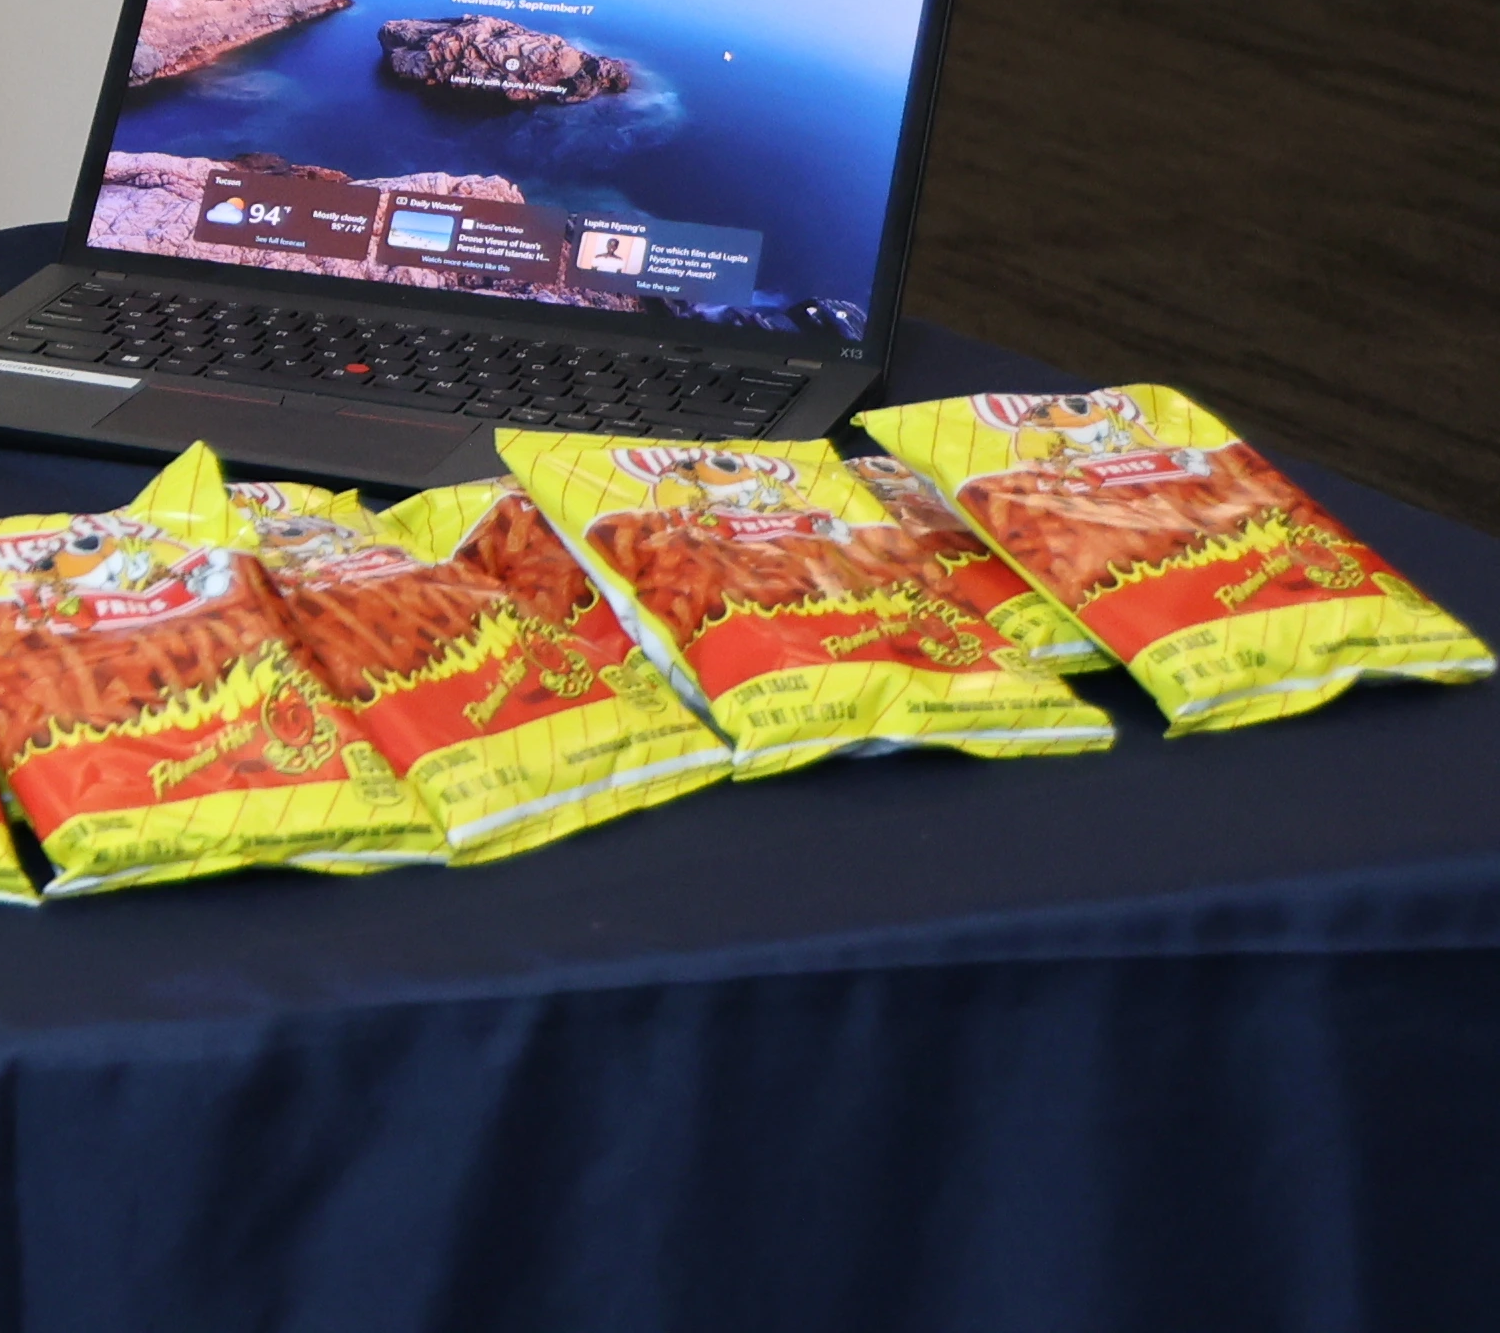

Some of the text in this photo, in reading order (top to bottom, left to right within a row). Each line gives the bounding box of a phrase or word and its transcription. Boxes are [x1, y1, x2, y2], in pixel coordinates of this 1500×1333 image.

[518, 0, 580, 15] September
[580, 4, 595, 16] 17
[450, 74, 471, 84] Level
[471, 76, 484, 87] Up
[484, 78, 501, 87] with
[502, 80, 525, 90] Azure
[535, 82, 568, 96] Foundry
[215, 176, 242, 188] Tucson
[410, 197, 463, 213] Daily Wonder
[249, 203, 282, 227] 94
[313, 209, 368, 226] Mostly cloudy
[504, 225, 524, 235] Video
[584, 218, 609, 230] Lupita
[280, 238, 306, 249] forecast
[458, 233, 485, 245] Drone
[486, 236, 508, 247] Views
[519, 240, 542, 251] Iran's
[456, 244, 486, 255] Persian
[487, 247, 505, 258] Gulf
[665, 245, 690, 257] which
[691, 247, 707, 258] film
[723, 252, 749, 265] Lupita
[421, 255, 443, 266] Watch
[463, 260, 484, 270] videos
[649, 254, 684, 268] Nyong'o
[647, 264, 717, 280] Academy Award?
[636, 280, 651, 290] Take
[839, 346, 864, 361] X13
[1093, 459, 1157, 478] FRIES
[94, 596, 169, 619] FRIES
